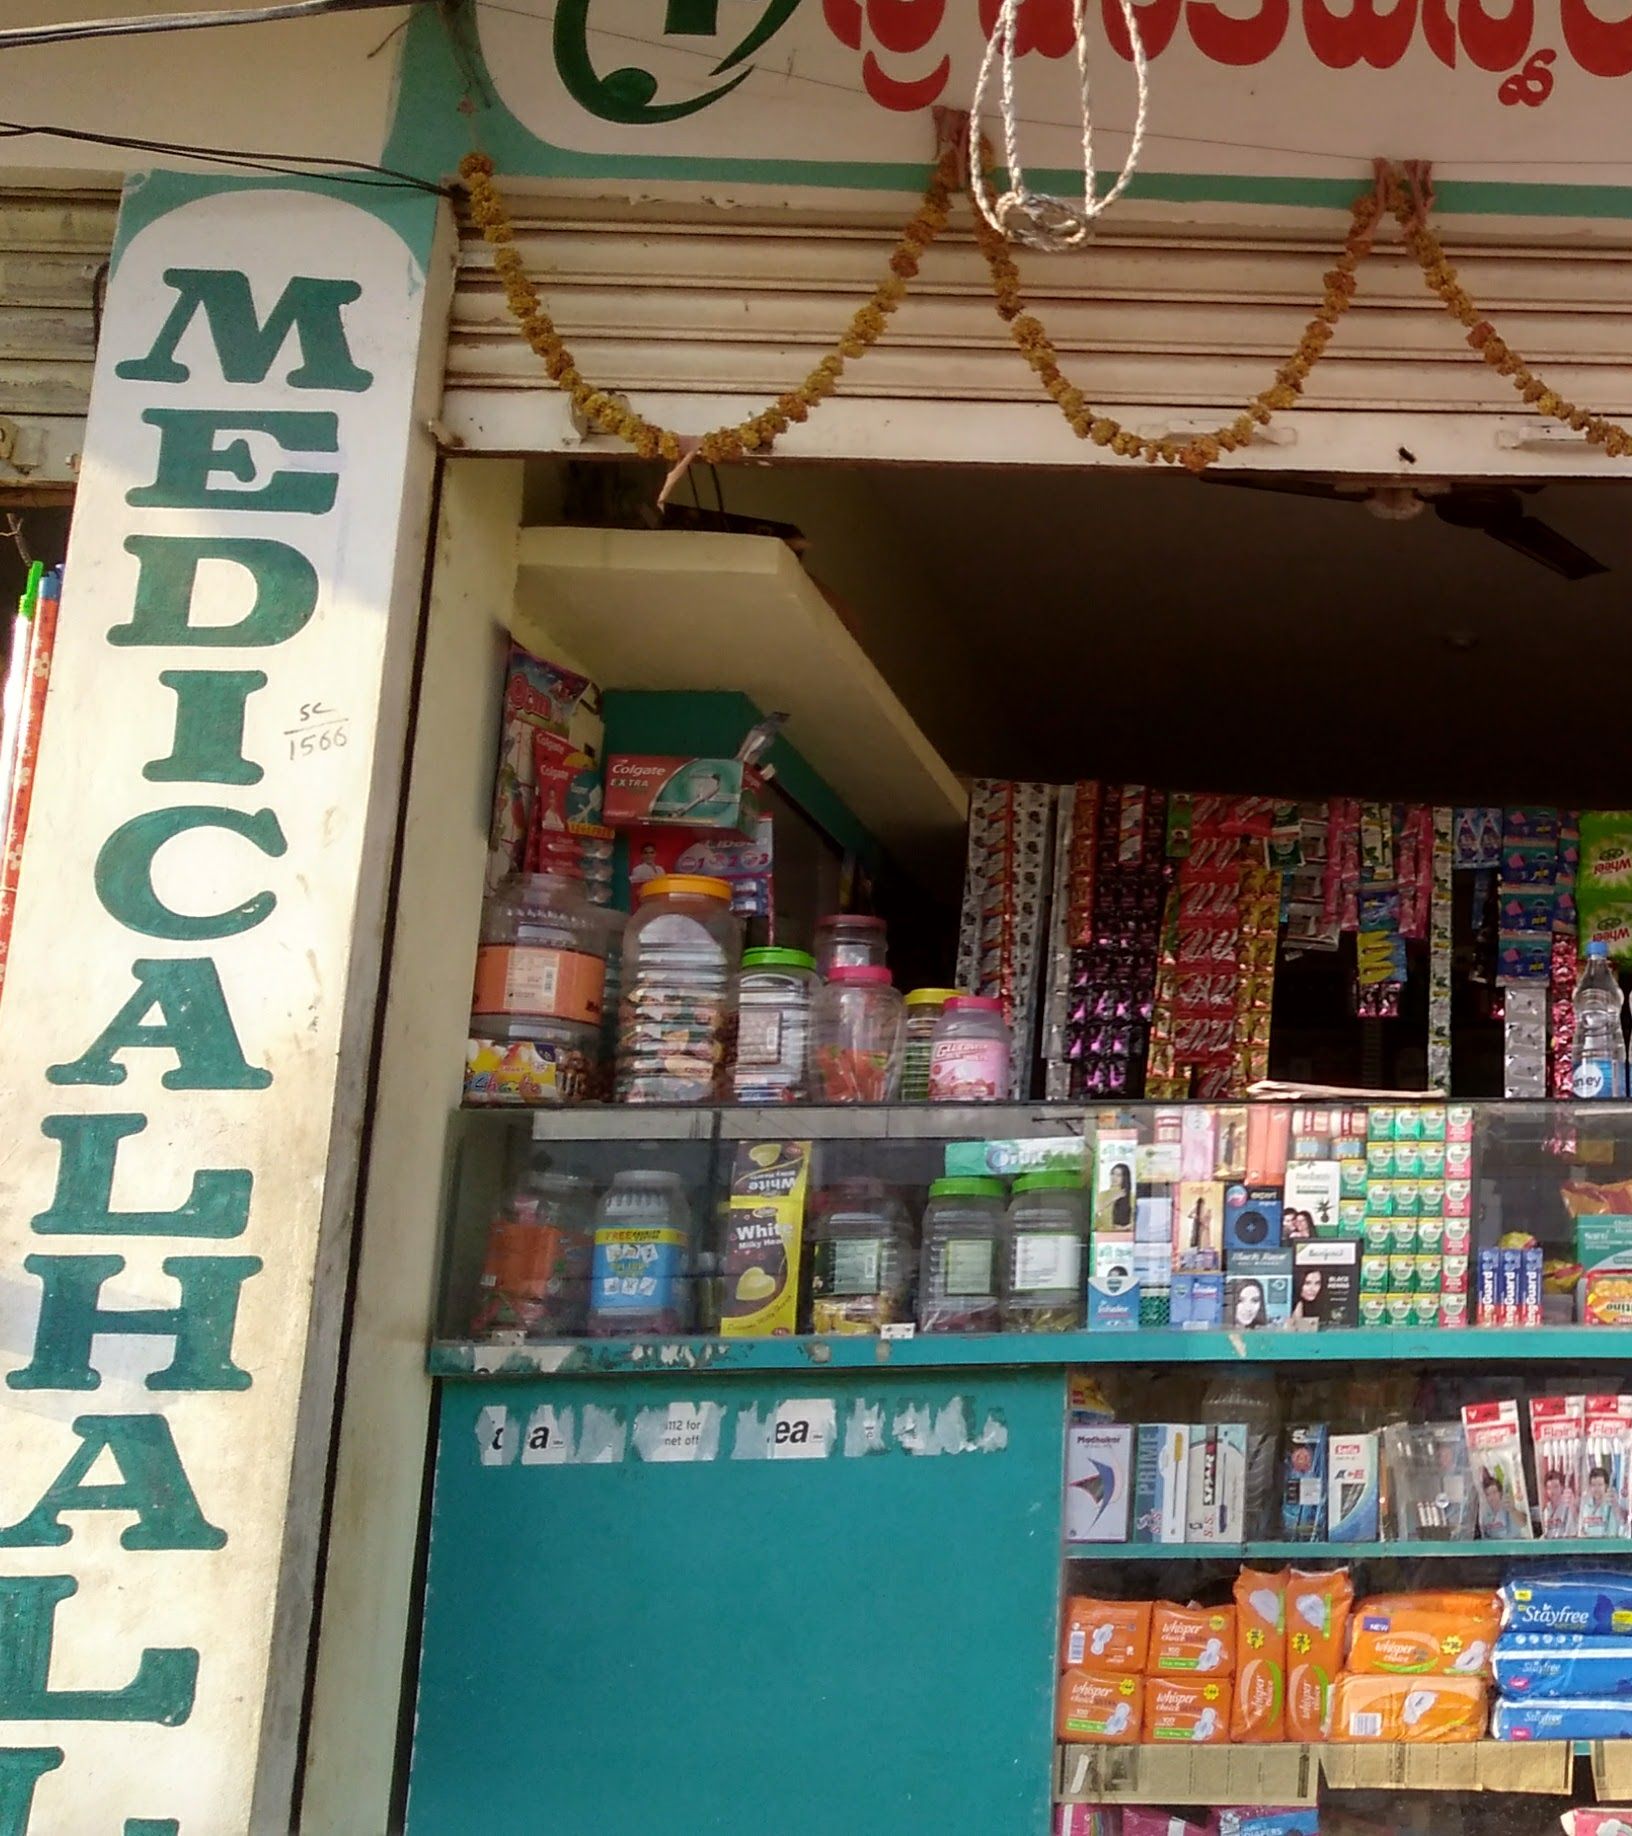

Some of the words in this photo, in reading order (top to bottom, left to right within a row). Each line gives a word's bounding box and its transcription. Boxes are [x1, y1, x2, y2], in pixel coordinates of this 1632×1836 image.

[289, 726, 348, 761] 1566
[612, 764, 667, 777] Colgate
[749, 1178, 796, 1191] White
[736, 1222, 793, 1241] White
[1140, 1426, 1158, 1495] PRIME
[1523, 1604, 1589, 1626] Stayfree
[1162, 1620, 1204, 1636] whisper
[1071, 1682, 1113, 1698] whisper
[1156, 1691, 1198, 1708] whisper
